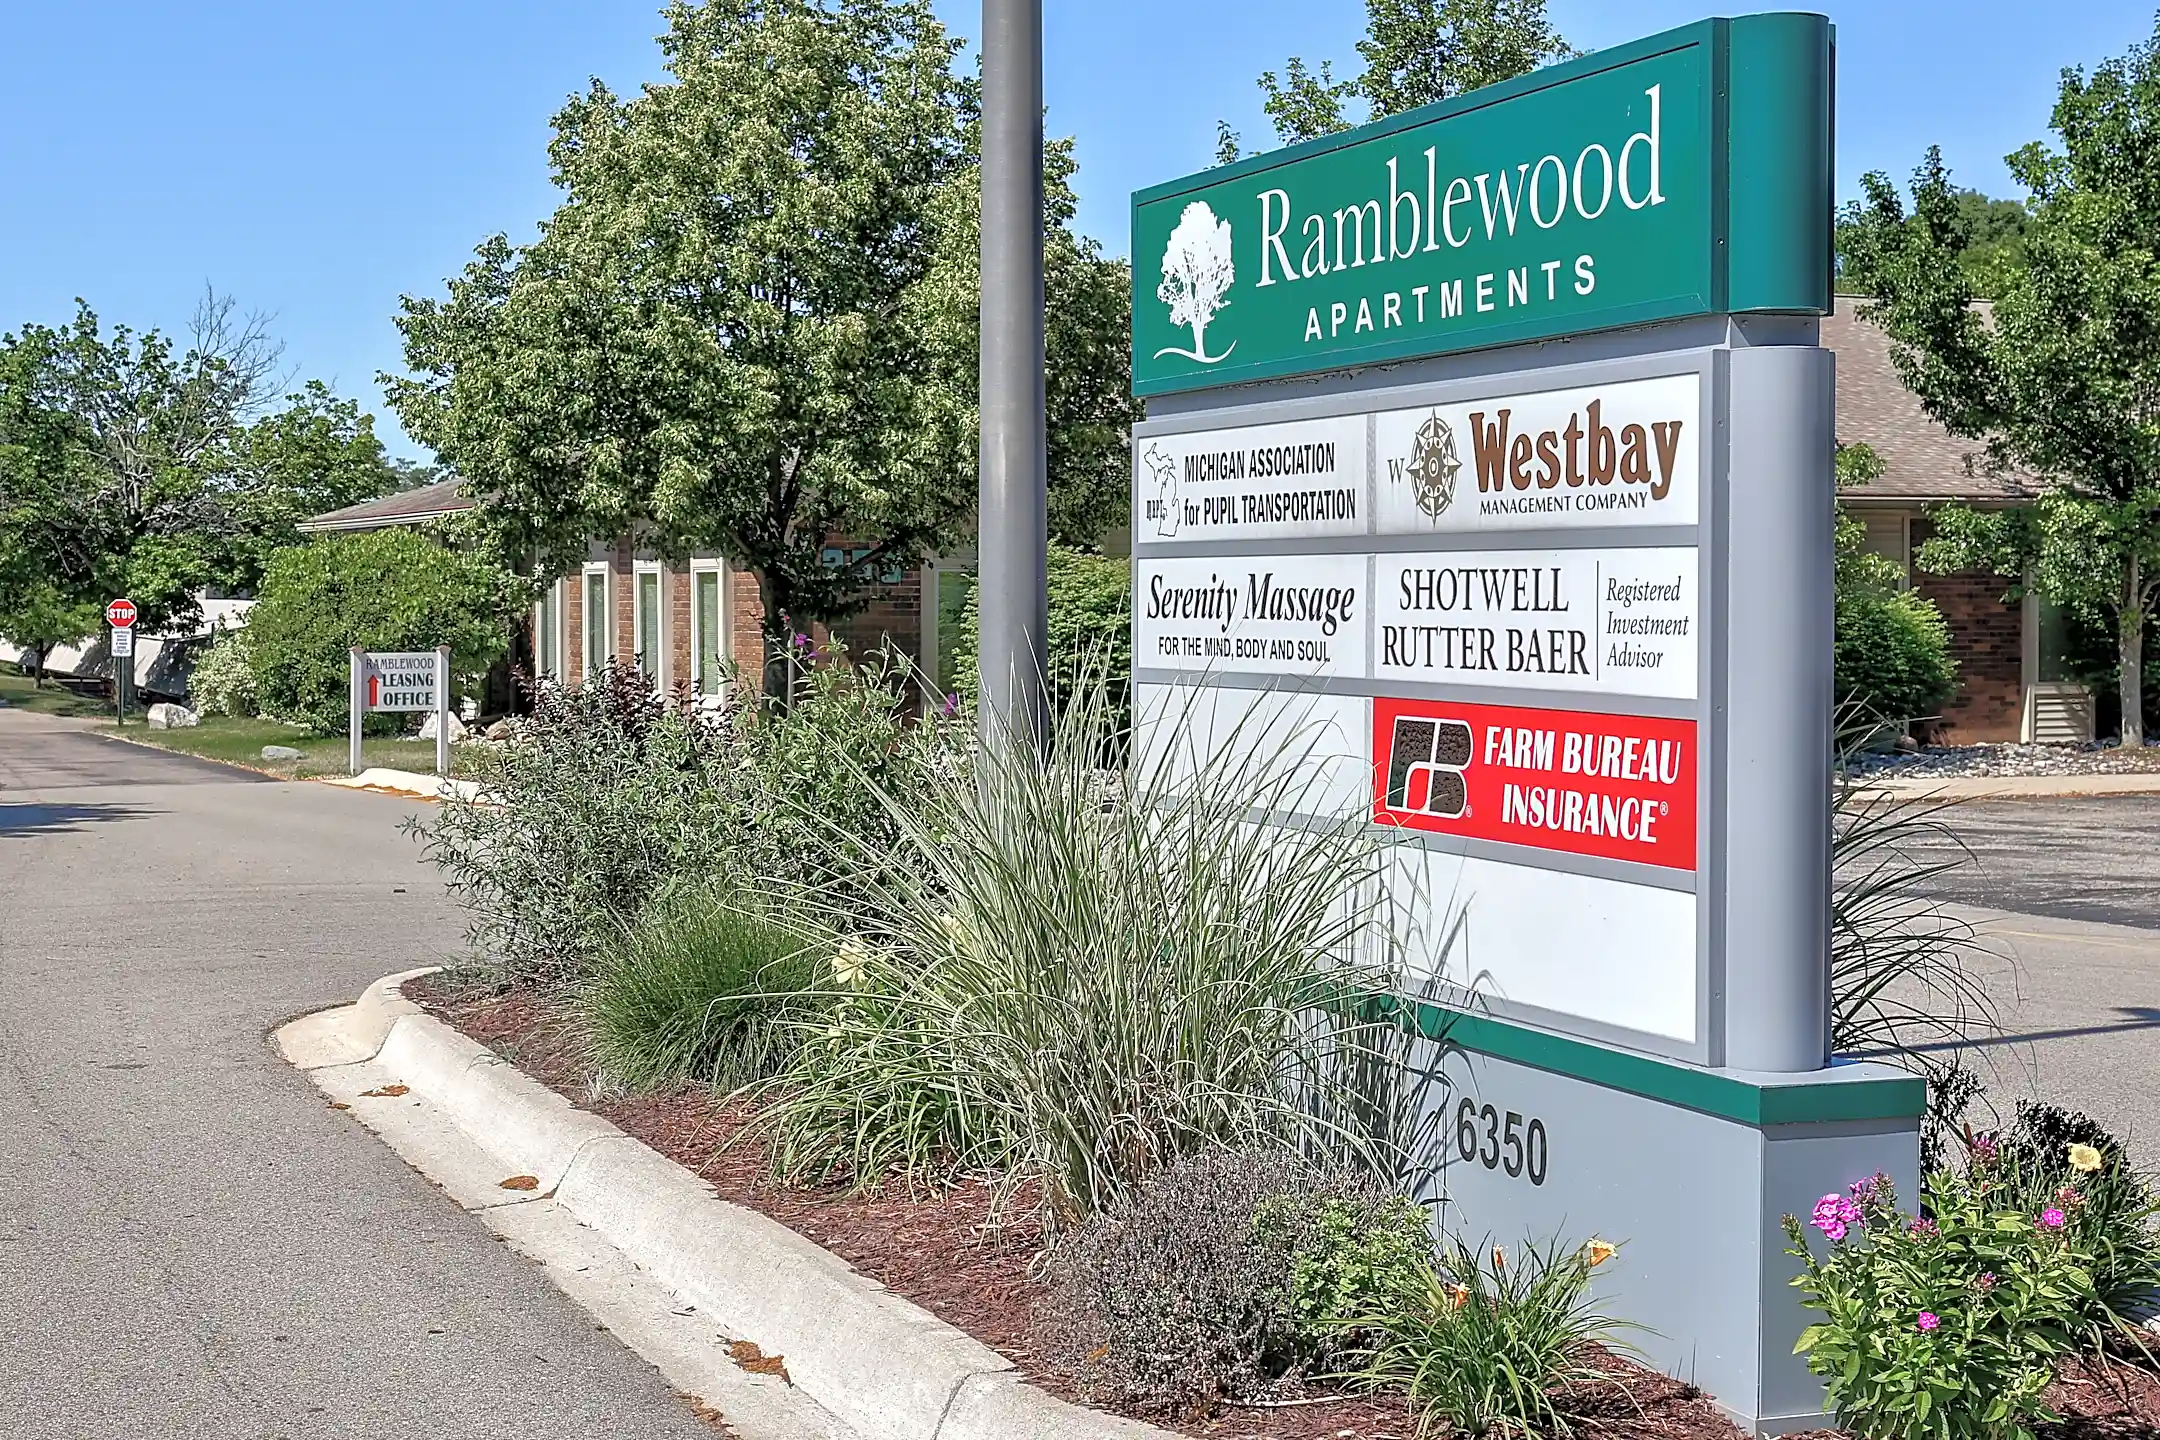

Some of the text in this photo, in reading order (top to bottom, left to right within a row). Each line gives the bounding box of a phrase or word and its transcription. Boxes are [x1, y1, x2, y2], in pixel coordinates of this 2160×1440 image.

[1255, 83, 1666, 288] Ramblewood
[1303, 254, 1596, 343] APARTMENTS
[1184, 442, 1335, 483] MICHIGAN ASSOCIATION
[1469, 398, 1683, 501] Westbay
[1388, 458, 1405, 484] W
[1184, 498, 1200, 526] for
[1204, 494, 1238, 525] PUPIL
[1241, 489, 1356, 524] TRANSPORTATION
[1479, 491, 1648, 516] MANAGEMENT COMPANY
[1147, 573, 1355, 636] Serenity Massage
[1399, 567, 1570, 613] SHOTWELL
[1606, 575, 1682, 608] Registered
[108, 607, 135, 620] STOP
[1606, 610, 1690, 637] Investment
[366, 658, 435, 670] RAMBLEWOOD
[1158, 636, 1180, 656] FOR
[1181, 636, 1202, 657] THE
[1204, 637, 1234, 661] MIND,
[1236, 638, 1268, 659] BODY
[1269, 639, 1294, 660] AND
[1382, 624, 1591, 675] RUTTER BAER
[1606, 641, 1664, 669] Advisor
[382, 672, 434, 687] LEASING
[383, 692, 433, 706] OFFICE
[1484, 725, 1682, 785] FARM BUREAU
[1457, 1097, 1547, 1186] 6350
